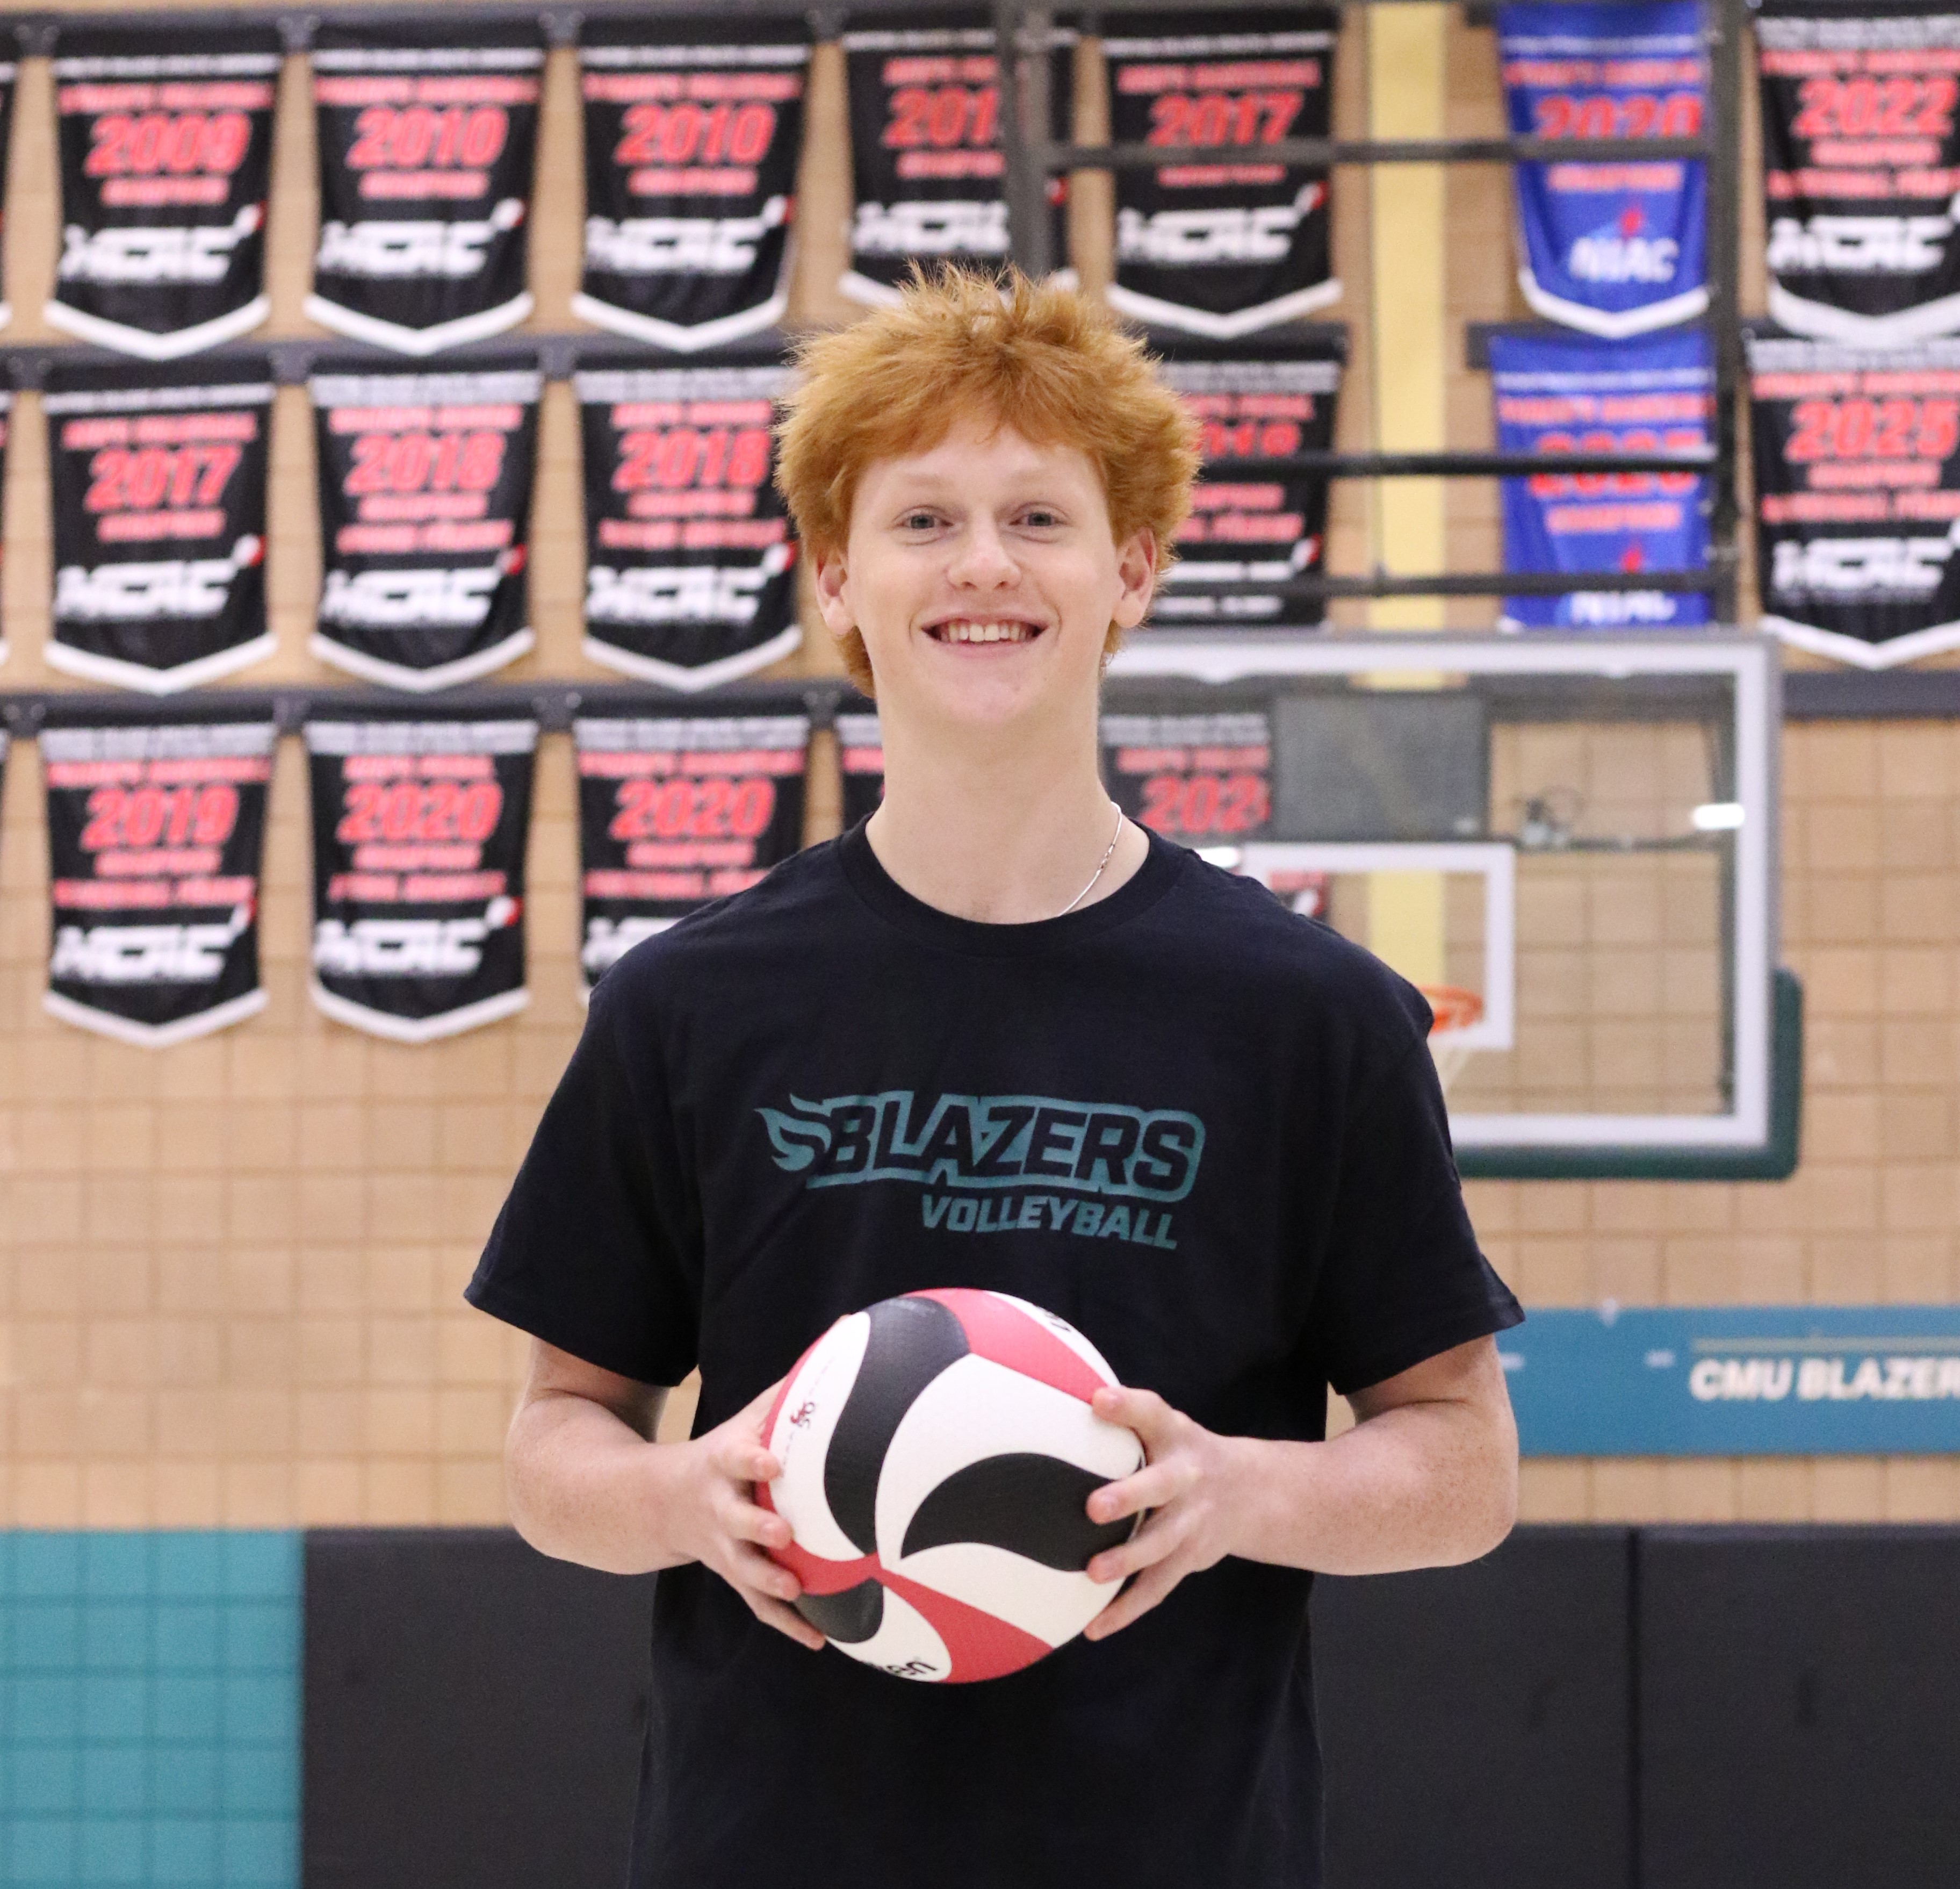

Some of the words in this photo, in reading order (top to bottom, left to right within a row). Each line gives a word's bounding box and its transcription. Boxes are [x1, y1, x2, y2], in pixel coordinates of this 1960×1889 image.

[345, 106, 509, 168] 2010
[614, 103, 777, 166] 2010
[884, 86, 1000, 148] 201
[1147, 90, 1306, 147] 2017
[1791, 78, 1959, 139] 2022
[611, 427, 774, 490] 2018
[1783, 399, 1960, 462] 2025
[83, 443, 243, 513] 2017
[343, 432, 506, 495] 2018
[80, 784, 240, 852] 2019
[334, 781, 505, 844] 2020
[609, 778, 777, 842] 2020
[809, 1091, 1206, 1202] BLAZERS
[921, 1193, 1177, 1249] VOLLEYBALL
[1690, 1358, 1793, 1401] CMU
